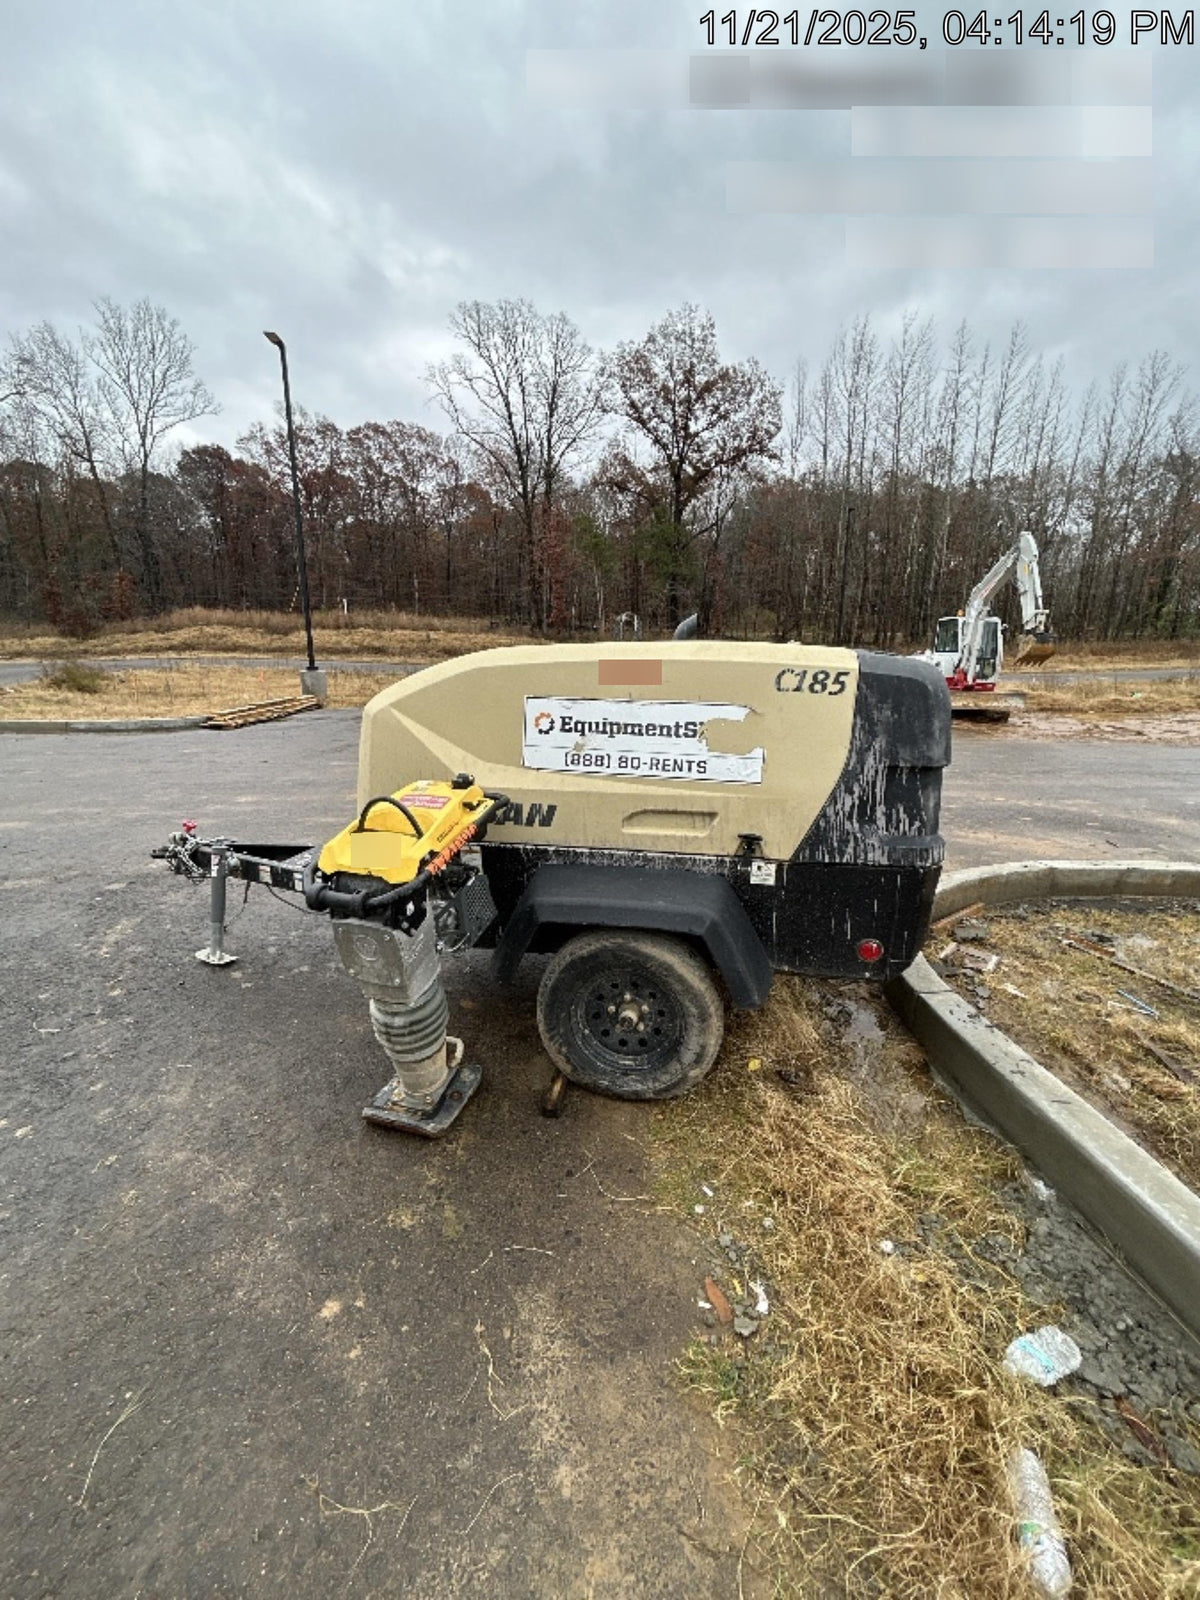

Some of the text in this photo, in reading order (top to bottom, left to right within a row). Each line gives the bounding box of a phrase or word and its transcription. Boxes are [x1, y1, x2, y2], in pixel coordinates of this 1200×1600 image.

[775, 668, 850, 695] C185
[559, 715, 705, 739] EquipmentS
[618, 755, 708, 774] 80-RENTS
[494, 802, 558, 828] AN
